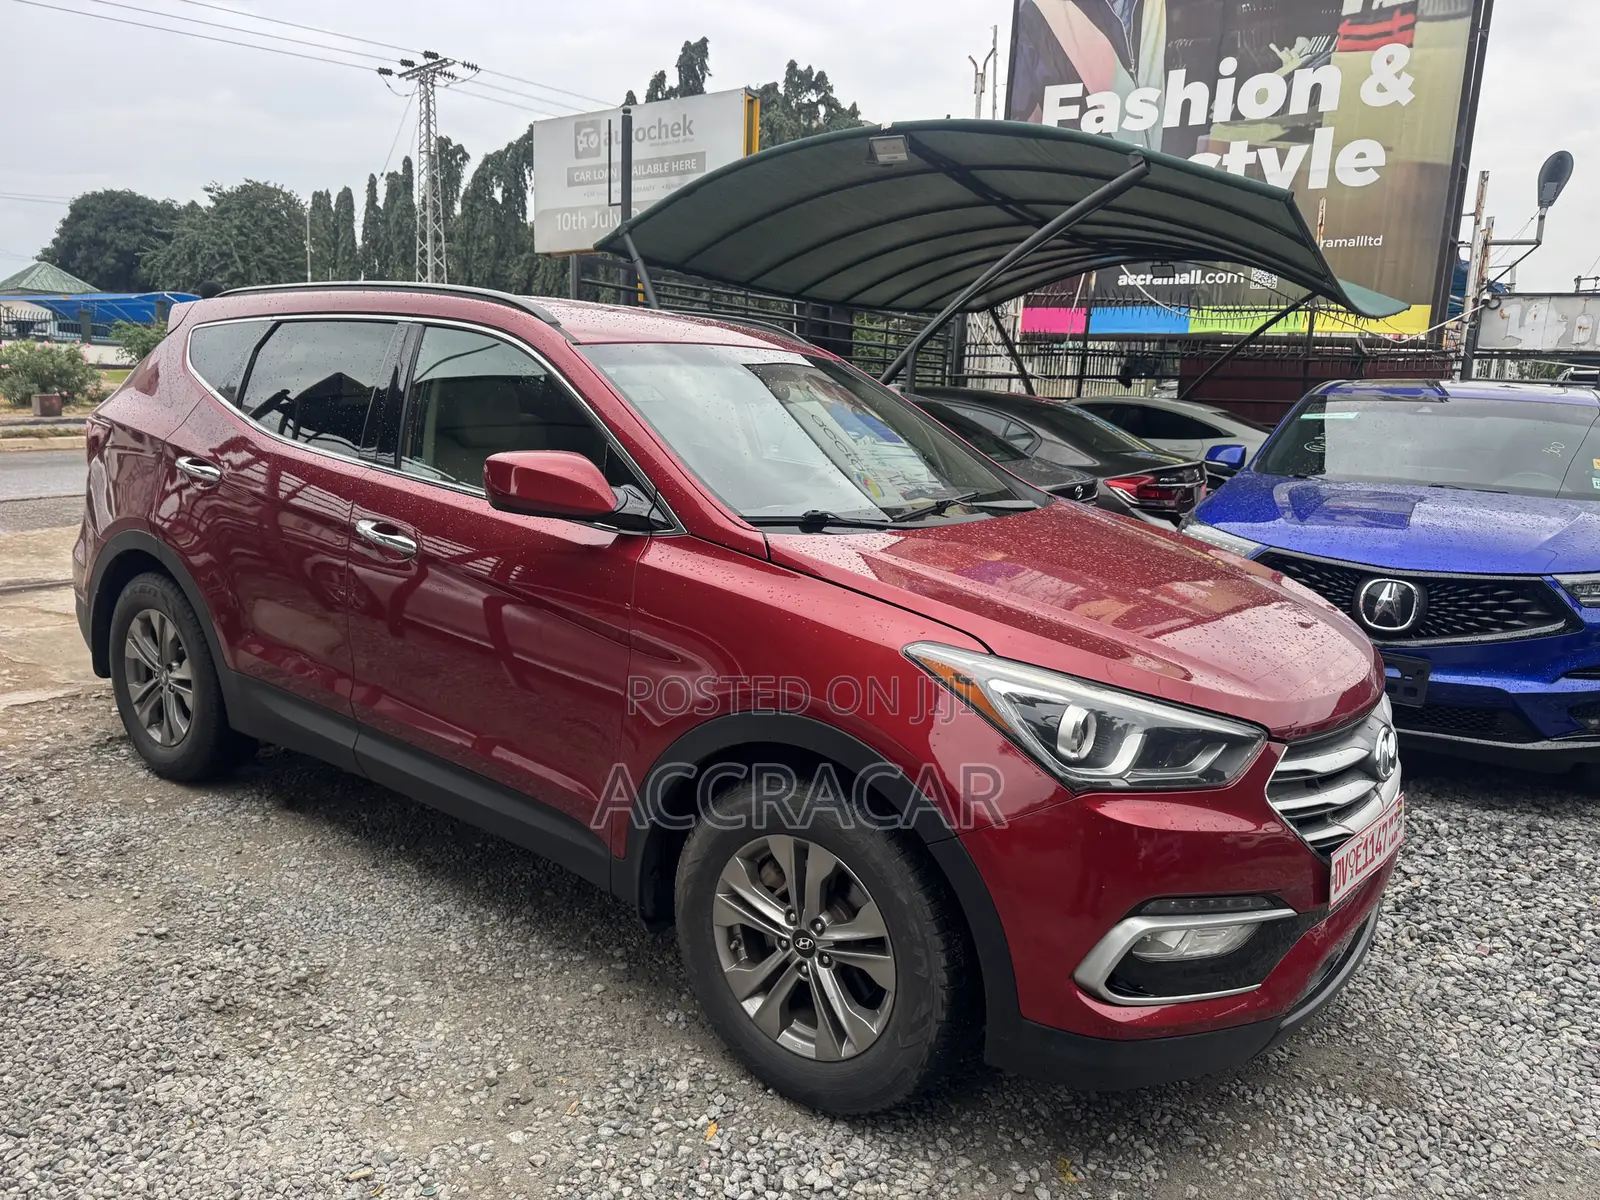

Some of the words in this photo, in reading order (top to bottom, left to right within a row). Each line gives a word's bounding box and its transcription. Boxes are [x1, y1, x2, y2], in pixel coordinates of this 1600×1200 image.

[1041, 57, 1342, 135] Fashion
[1359, 43, 1416, 107] &
[603, 114, 694, 146] auochek
[574, 170, 592, 182] CAR
[631, 162, 669, 176] AILABLE
[672, 158, 697, 172] HERE
[556, 211, 587, 231] 10th
[591, 207, 622, 229] July
